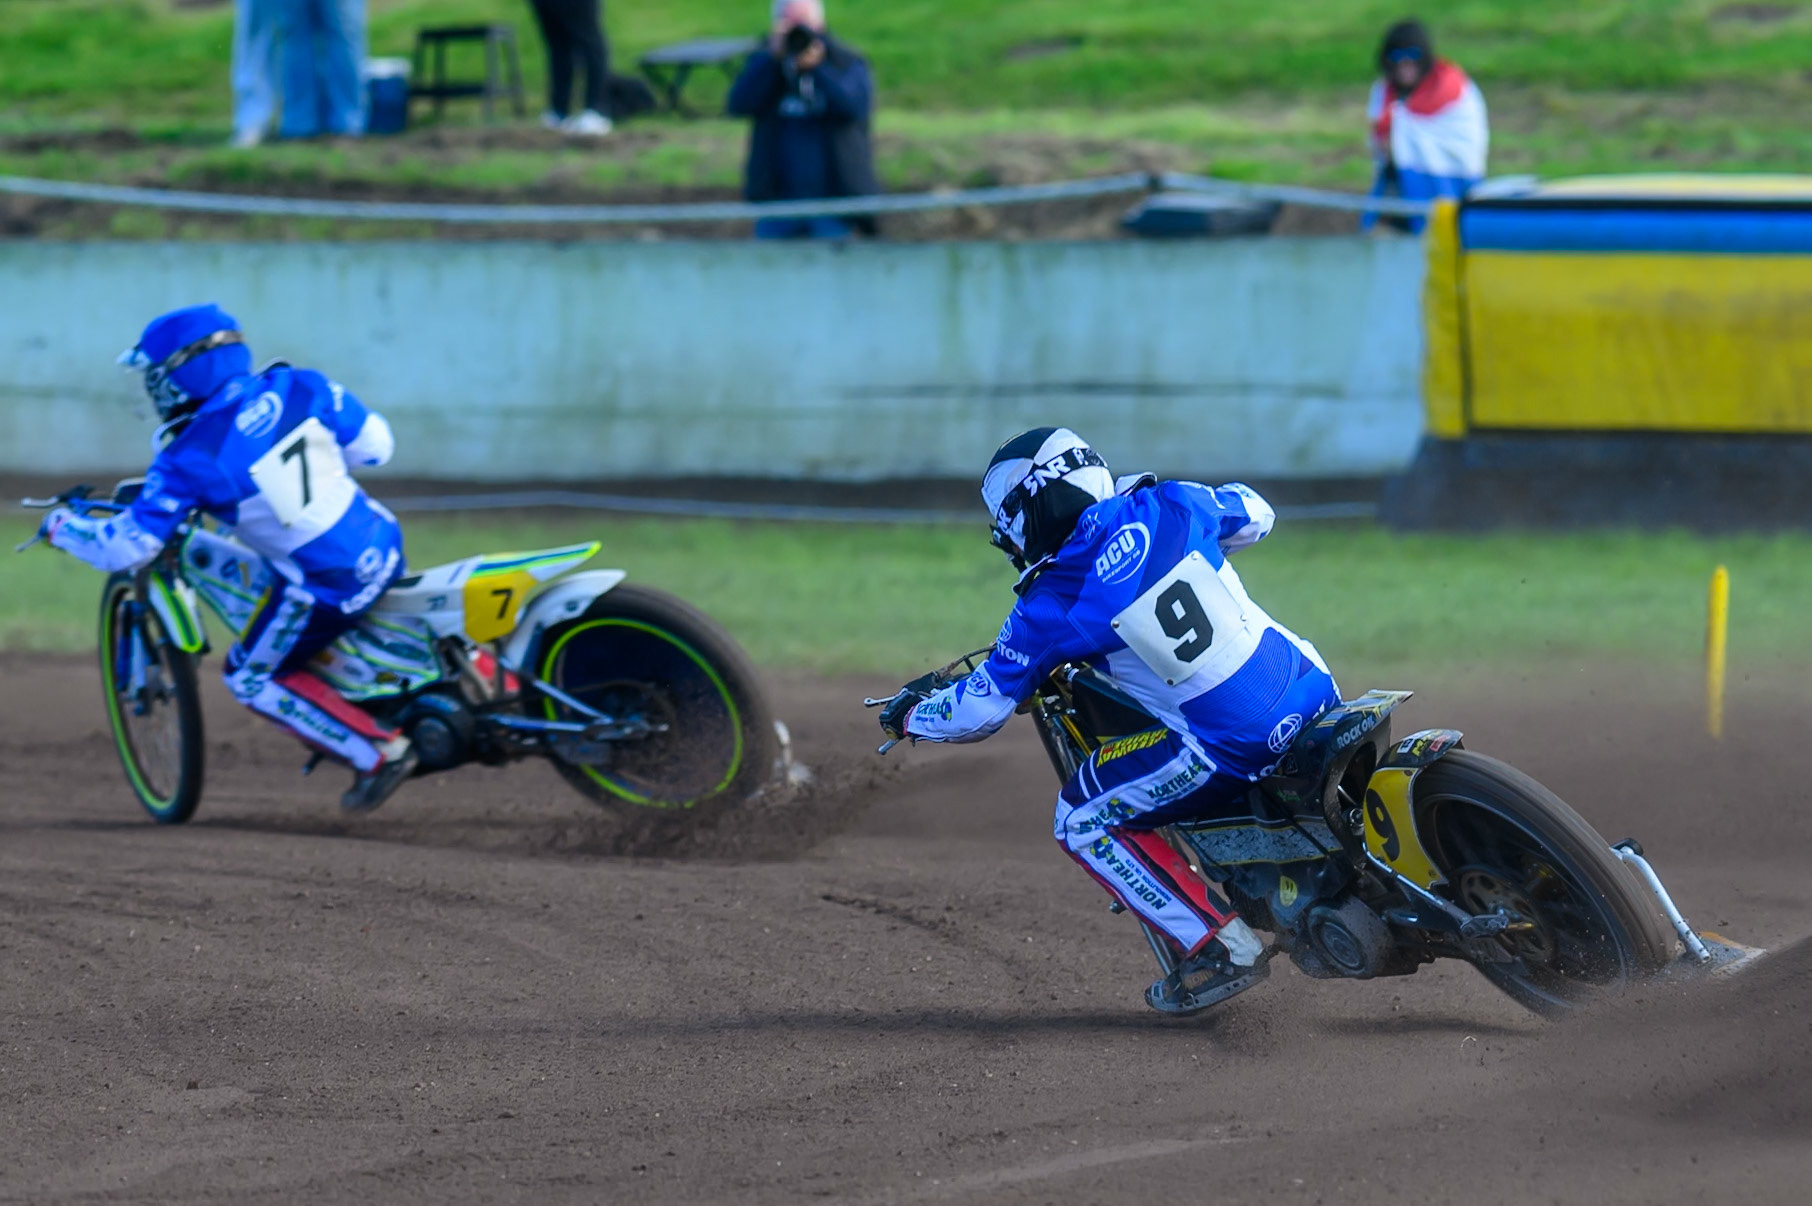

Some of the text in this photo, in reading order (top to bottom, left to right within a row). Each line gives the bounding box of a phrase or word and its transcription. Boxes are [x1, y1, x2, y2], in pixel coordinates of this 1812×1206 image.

[280, 436, 311, 508] 7
[1023, 456, 1071, 497] SNR
[1096, 530, 1136, 577] ACU
[490, 587, 514, 619] 7
[1155, 579, 1213, 663] 9
[1337, 723, 1362, 749] ROCK
[1365, 788, 1400, 862] 9
